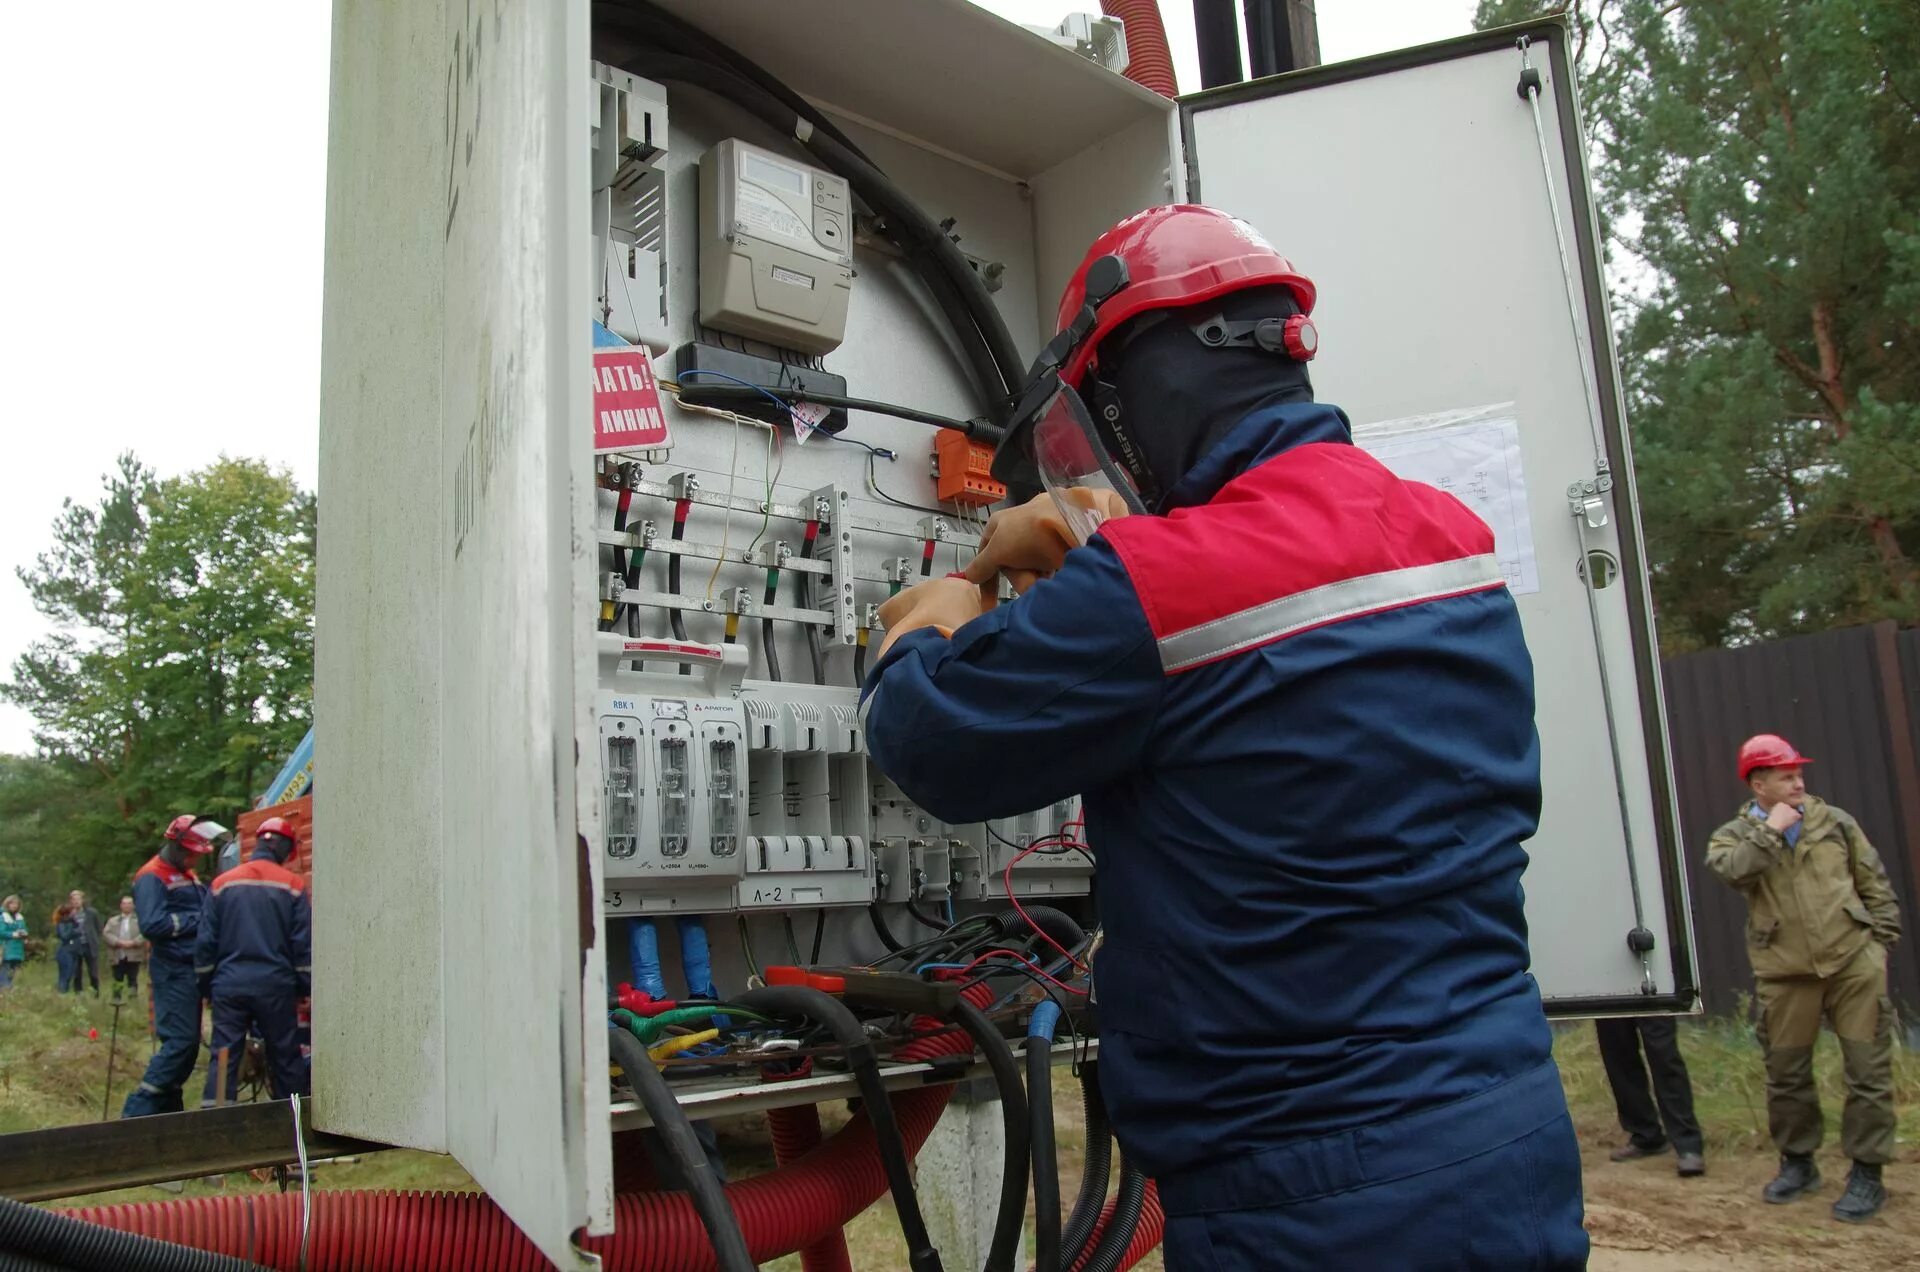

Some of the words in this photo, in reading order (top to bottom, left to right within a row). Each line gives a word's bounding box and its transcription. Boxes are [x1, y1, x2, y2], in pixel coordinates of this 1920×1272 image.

[600, 406, 662, 434] ЛИНИИ
[1103, 403, 1142, 475] ЭНЕРГО
[613, 700, 628, 709] RBK
[704, 704, 734, 712] APATOR
